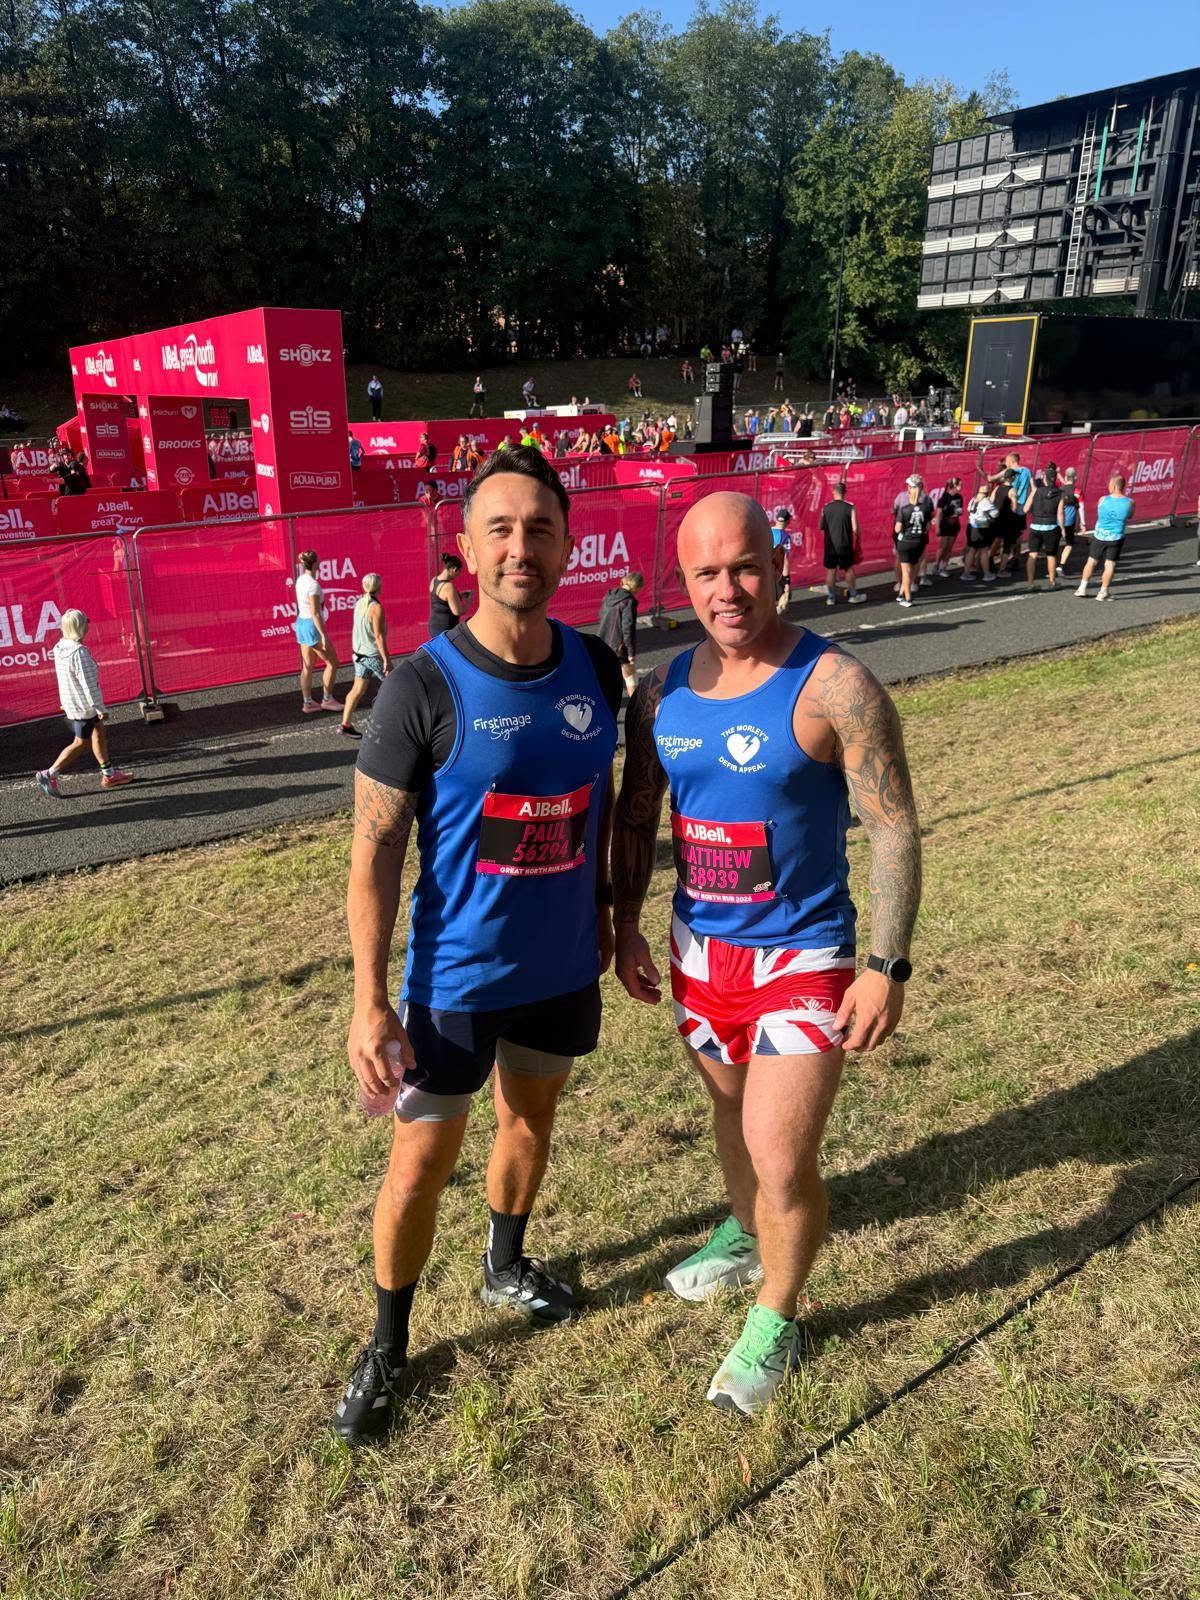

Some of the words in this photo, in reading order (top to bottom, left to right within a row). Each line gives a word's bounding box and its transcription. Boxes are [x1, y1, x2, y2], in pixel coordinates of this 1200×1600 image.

[279, 347, 332, 363] SHOKZ
[90, 401, 119, 410] SHOKZ
[158, 440, 202, 449] BROOKS
[293, 475, 316, 485] AQUA
[316, 476, 338, 487] PURA
[91, 517, 116, 529] great
[125, 516, 144, 524] run
[554, 698, 567, 712] THE
[565, 693, 596, 707] MORLEY'S
[473, 714, 532, 731] Firstimage
[561, 728, 581, 741] DEFIB
[581, 725, 603, 741] APPEAL
[720, 726, 736, 738] THE
[736, 724, 769, 743] MORLEY'S
[657, 734, 703, 749] Firstimage
[718, 756, 737, 772] DEFIB
[738, 761, 767, 774] APPEAL
[522, 821, 567, 842] PAUL
[512, 839, 570, 863] 56294
[679, 842, 753, 869] MATTHEW
[500, 866, 524, 875] GREAT
[525, 867, 548, 875] NORTH
[690, 865, 739, 889] 58939
